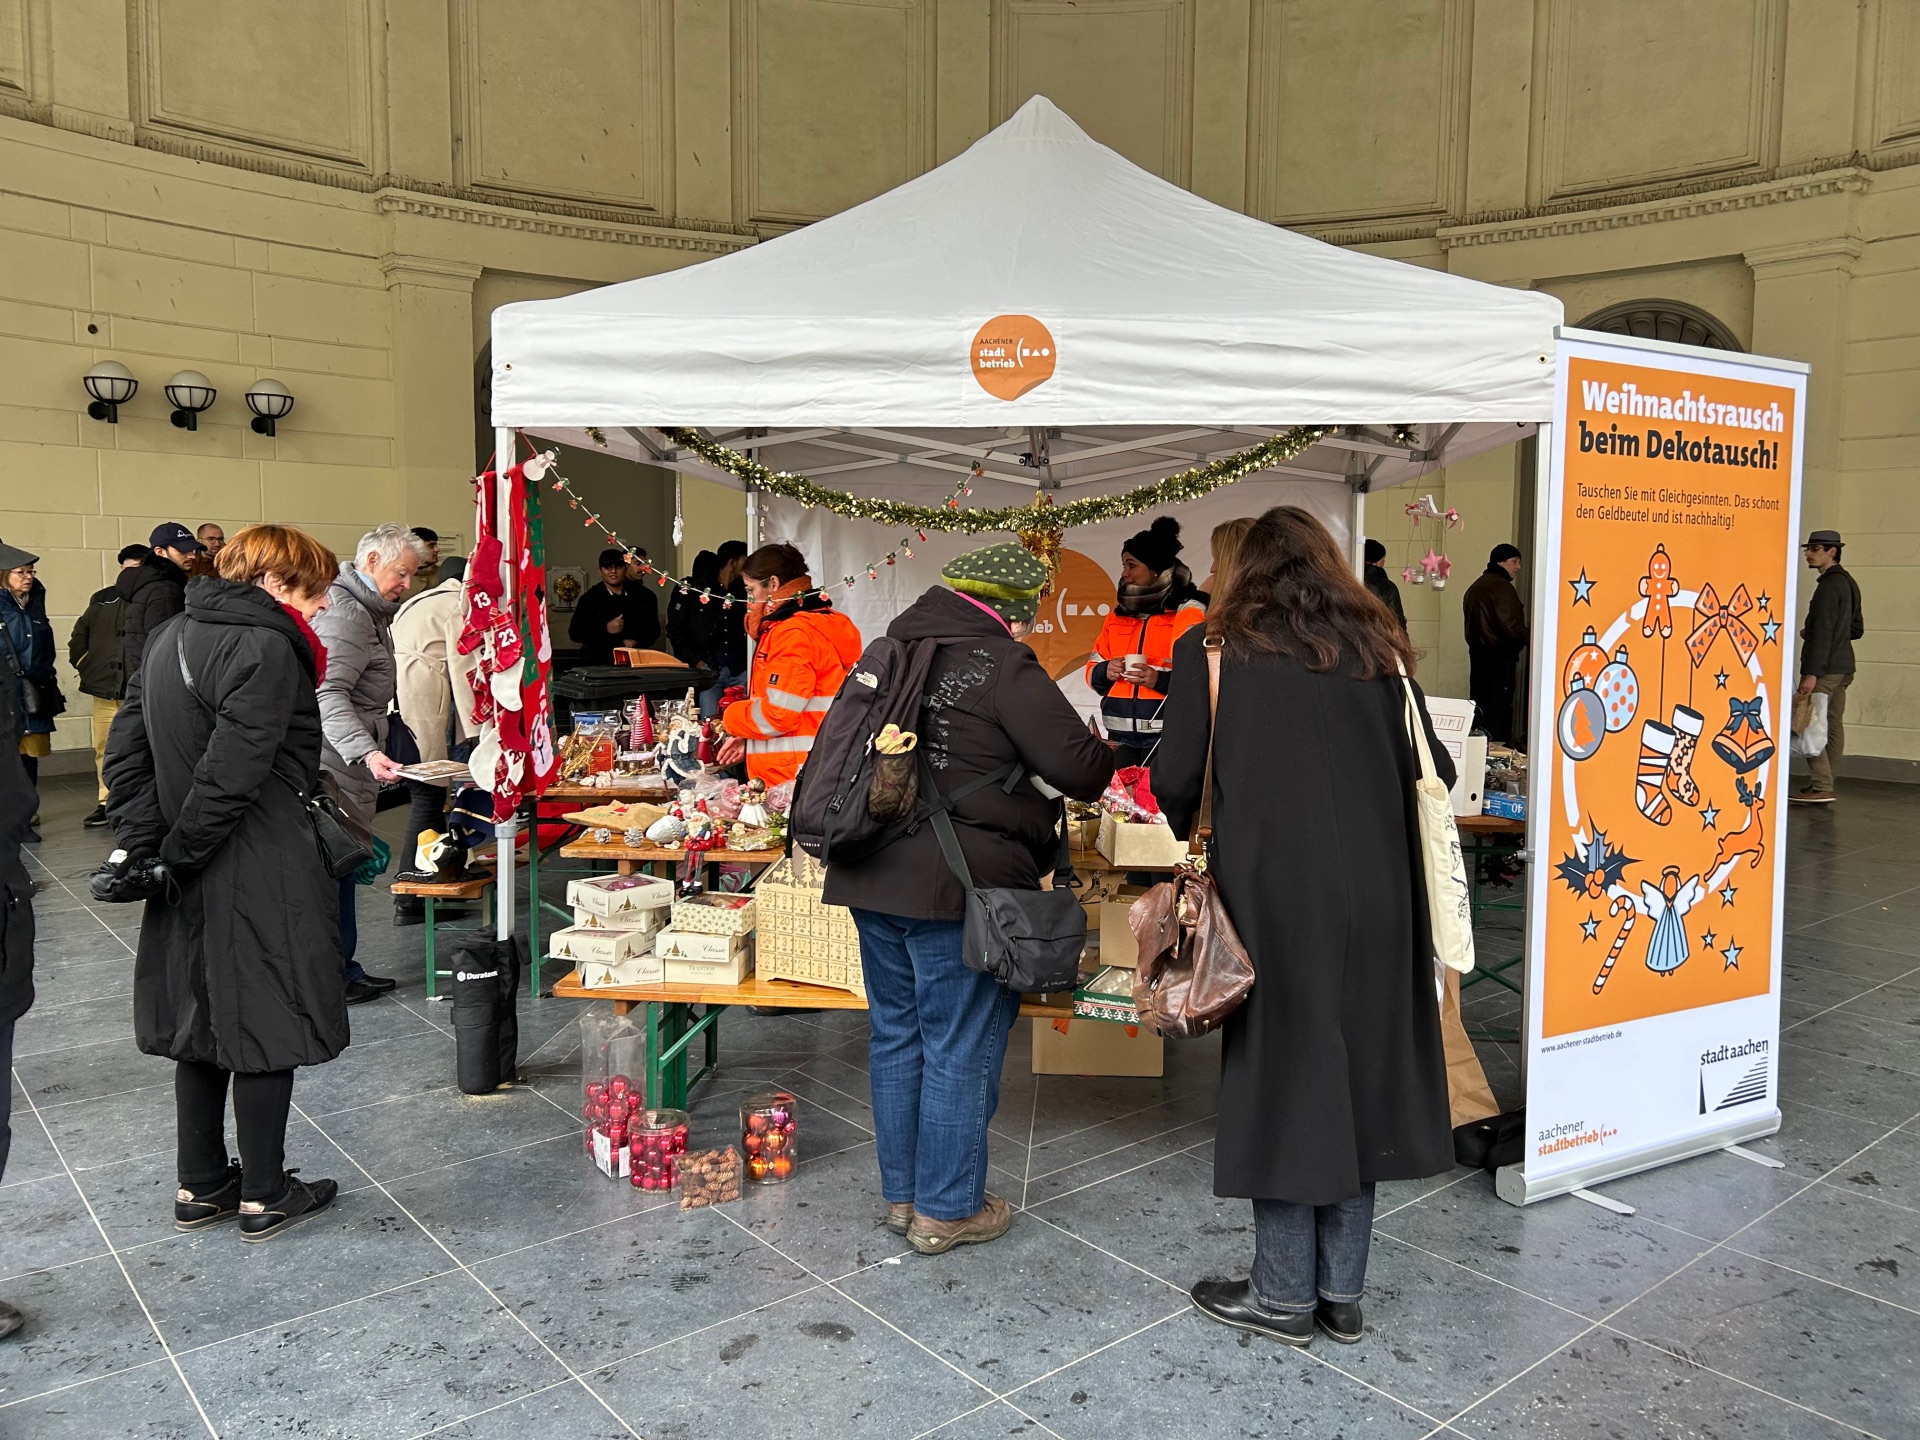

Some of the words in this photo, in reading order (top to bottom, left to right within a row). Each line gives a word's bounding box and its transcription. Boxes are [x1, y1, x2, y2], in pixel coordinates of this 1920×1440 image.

[979, 347, 1005, 357] stadt
[979, 358, 1015, 368] betrieb
[1581, 379, 1784, 433] Weihnachtsrausch
[1578, 420, 1640, 457] beim
[1646, 429, 1779, 470] Dekotausch!
[1577, 482, 1621, 499] Tauschen
[1624, 486, 1638, 500] Sie
[1640, 487, 1656, 502] mit
[1658, 488, 1732, 507] Gleichgesinnten.
[1734, 494, 1750, 508] Das
[1752, 495, 1780, 511] schont
[1576, 503, 1595, 519] den
[1597, 505, 1650, 522] Geldbeutel
[1652, 508, 1669, 523] und
[1671, 509, 1683, 524] ist
[1685, 510, 1735, 530] nachhaltig!
[474, 591, 491, 608] 13
[498, 628, 517, 648] 23
[763, 893, 773, 902] 23
[783, 895, 787, 904] 9
[761, 913, 773, 923] 22
[779, 916, 791, 926] 20
[798, 919, 807, 929] 13
[703, 944, 726, 953] Classic
[783, 937, 787, 946] 3
[636, 966, 661, 976] Classic
[780, 957, 790, 968] 24
[1541, 1030, 1622, 1053] www.aachener-stadtbetrieb.de
[1700, 1045, 1729, 1066] stadt
[1730, 1039, 1768, 1059] aachen
[1538, 1120, 1584, 1141] aachener
[1538, 1129, 1599, 1157] stadtbetrieb
